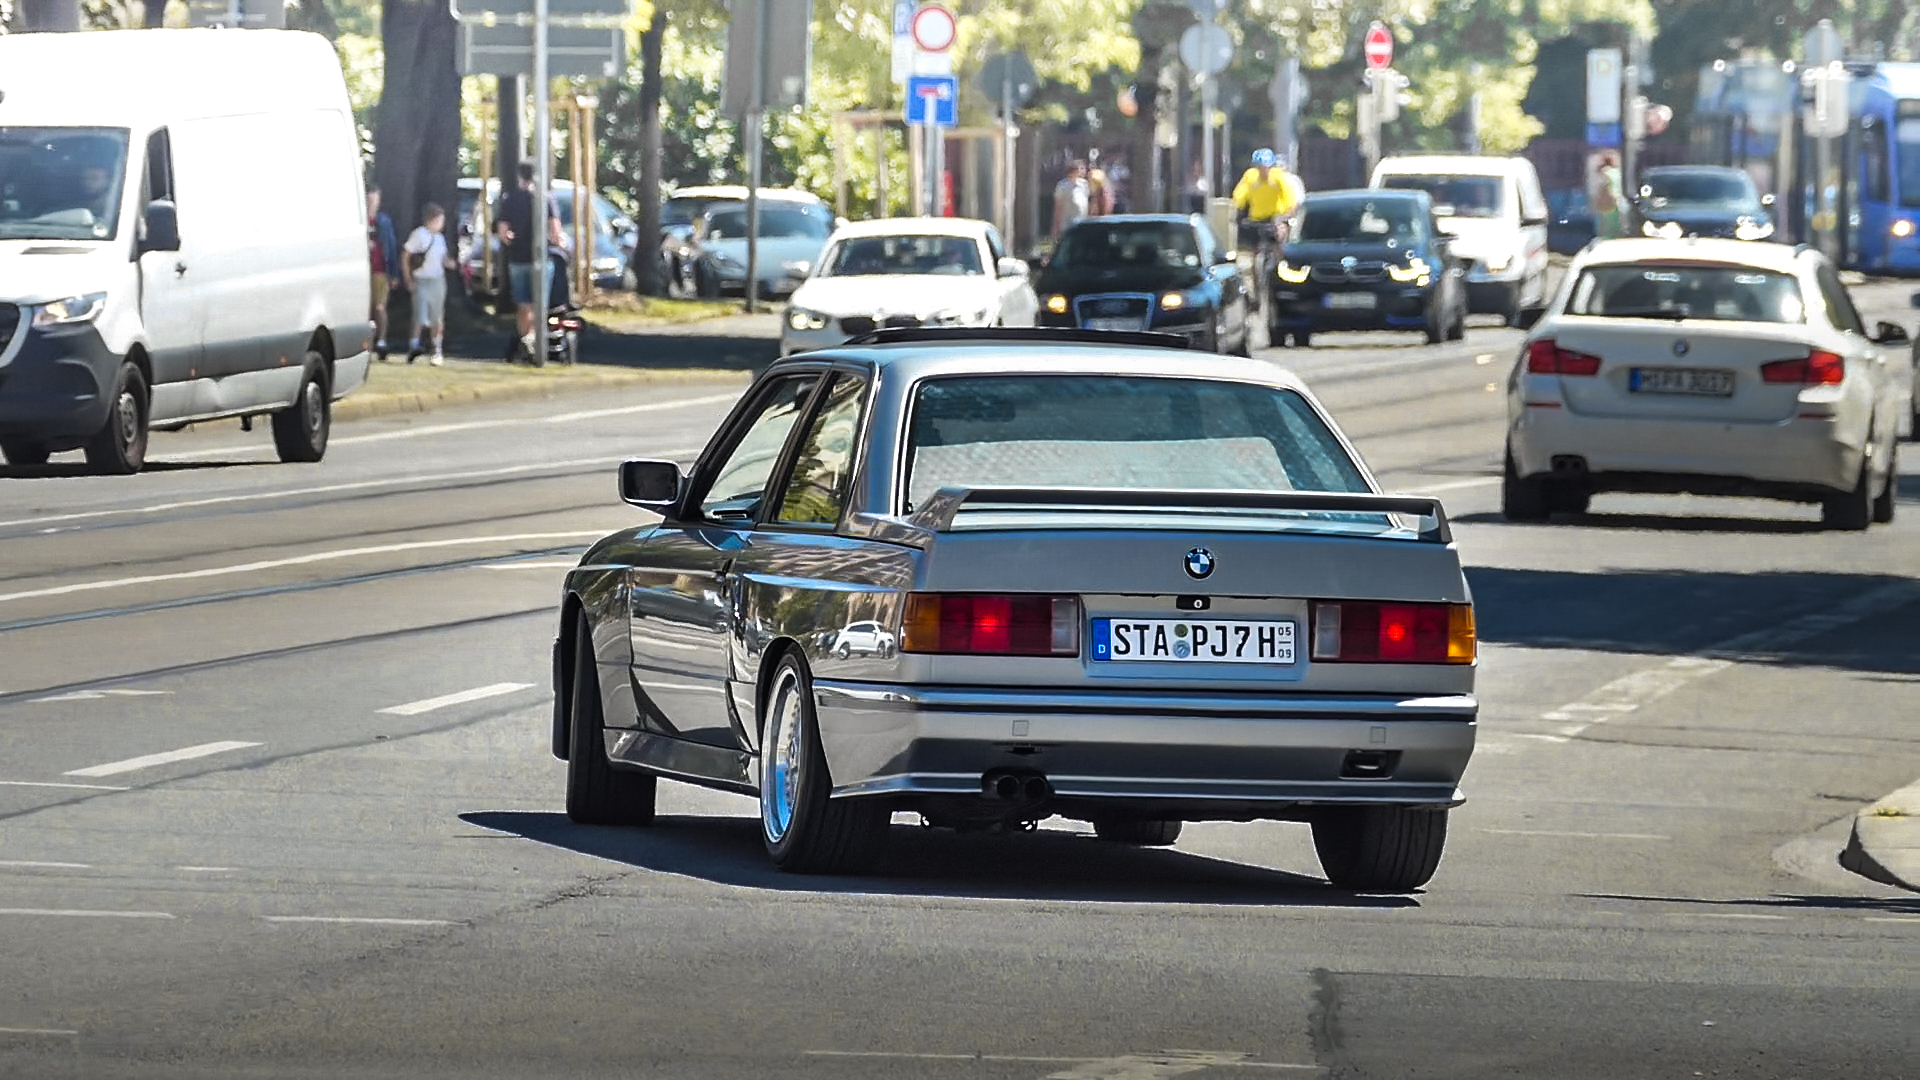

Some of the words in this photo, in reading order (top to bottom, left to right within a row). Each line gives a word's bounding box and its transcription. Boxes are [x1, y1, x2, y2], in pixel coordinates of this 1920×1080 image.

[1278, 626, 1292, 636] 05
[1114, 624, 1169, 656] STA
[1098, 644, 1106, 653] D
